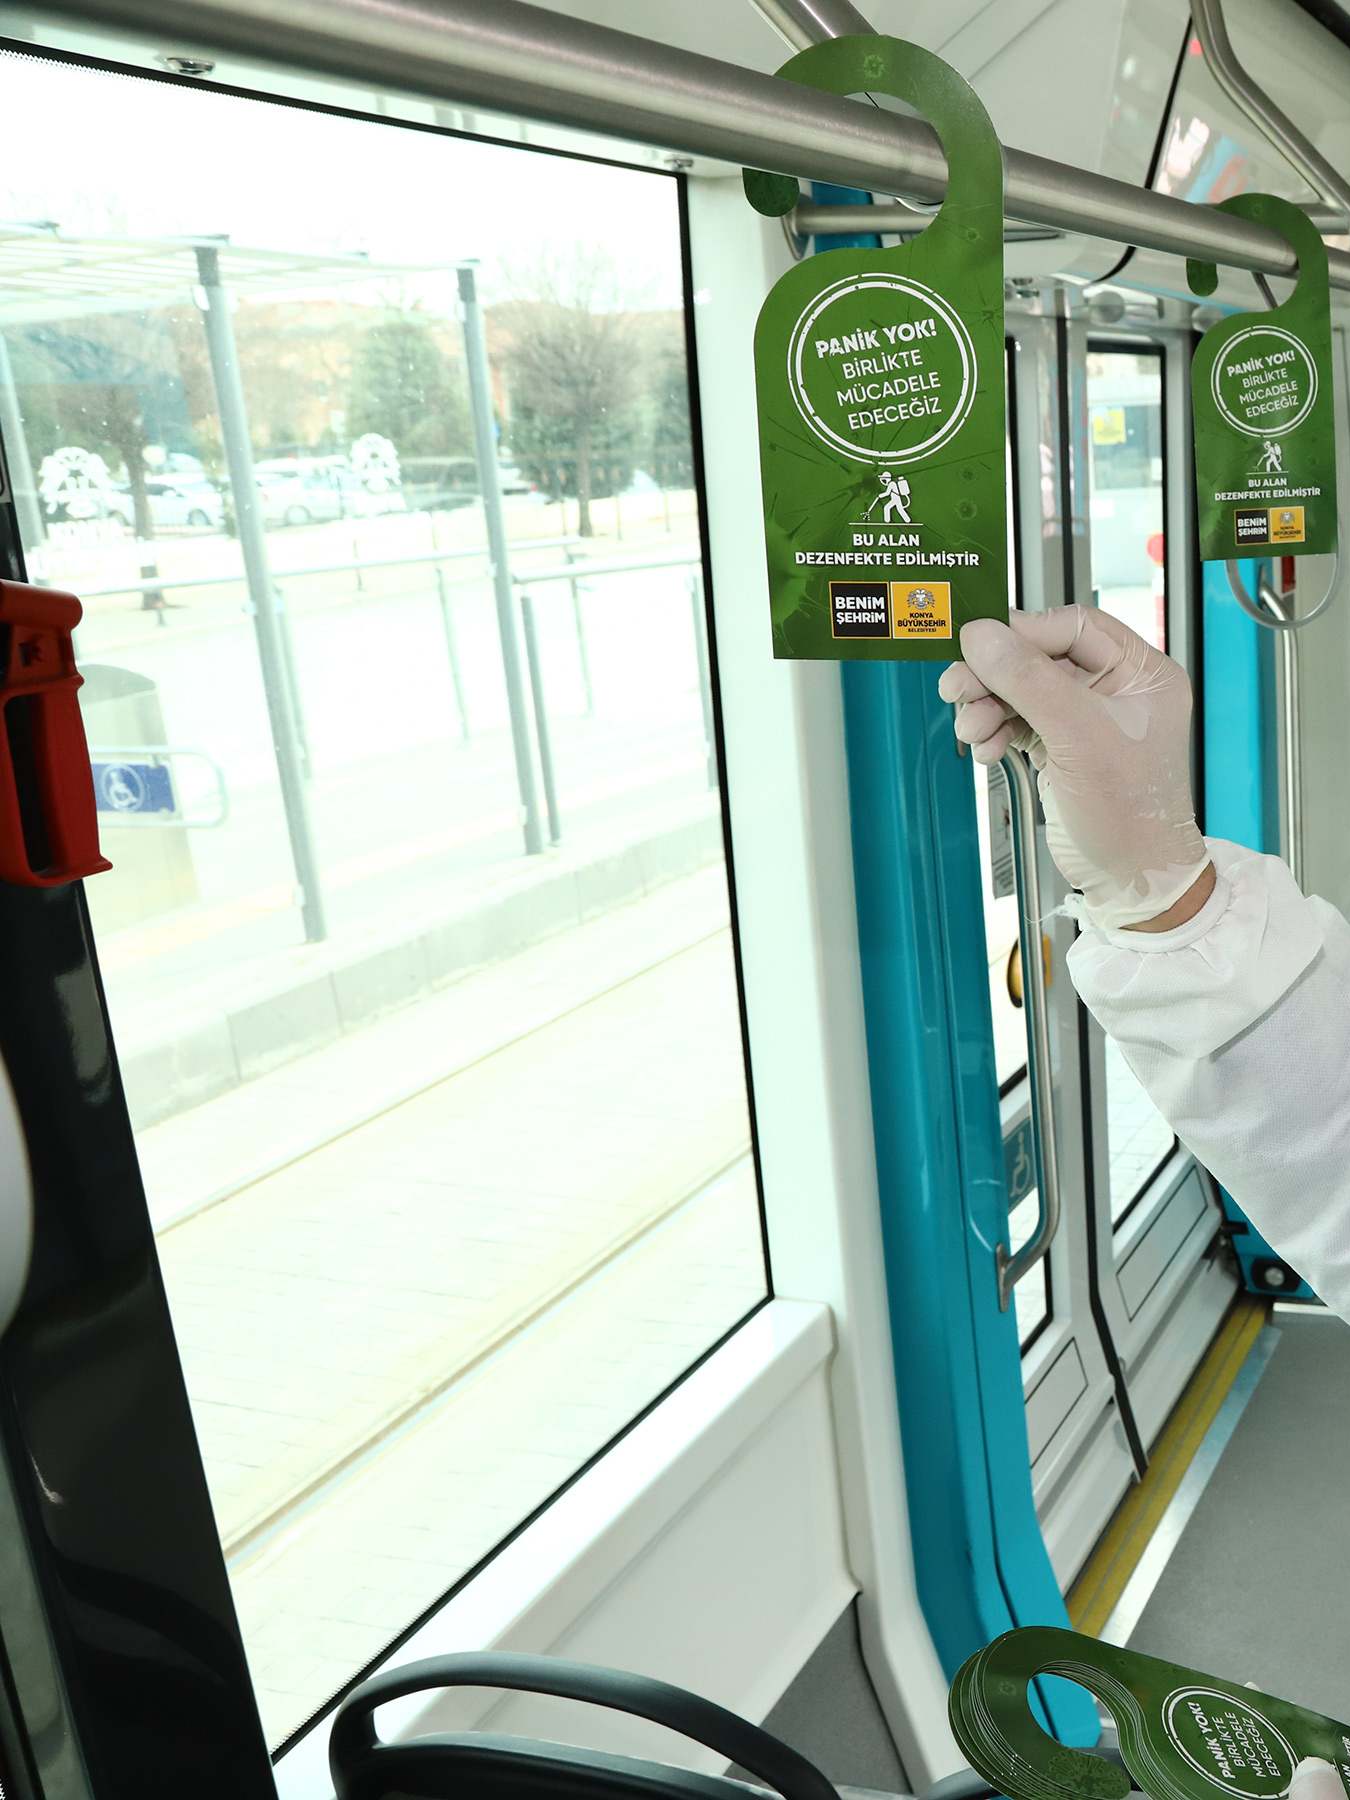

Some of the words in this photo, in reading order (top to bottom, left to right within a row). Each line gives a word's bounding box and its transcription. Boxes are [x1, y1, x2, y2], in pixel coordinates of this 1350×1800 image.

[815, 328, 880, 359] PANİK
[883, 319, 937, 343] YOK!
[842, 349, 922, 379] BİRLİKTE
[1227, 358, 1265, 377] PANİK
[1265, 350, 1295, 366] YOK!
[836, 372, 941, 407] MÜCADELE
[1243, 368, 1288, 389] BİRLİKTE
[1239, 381, 1298, 404] MÜCADELE
[848, 395, 942, 430] EDECEĞİZ
[1246, 395, 1299, 418] EDECEĞİZ
[1215, 489, 1271, 501] DEZENFEKTE
[1273, 486, 1320, 499] EDİLMİŞTİR
[1249, 479, 1260, 487] BU
[1263, 478, 1287, 486] ALAN
[1237, 517, 1266, 528] BENİM
[1238, 527, 1267, 537] ŞEHRİM
[853, 534, 875, 547] BU
[878, 534, 919, 546] ALAN
[795, 551, 893, 566] DEZENFEKTE
[896, 549, 979, 568] EDİLMİŞTİR
[835, 595, 884, 610] BENİM
[836, 609, 885, 625] ŞEHRİM
[897, 618, 946, 628] BÜYÜKŞEHİR
[909, 612, 934, 620] KONYA
[1187, 1701, 1214, 1737] YOK!
[1212, 1716, 1247, 1768] BİRLİKTE
[1224, 1711, 1267, 1778] MÜCADELE
[1242, 1717, 1281, 1777] EDECEĞİZ
[1204, 1737, 1236, 1780] PANİK
